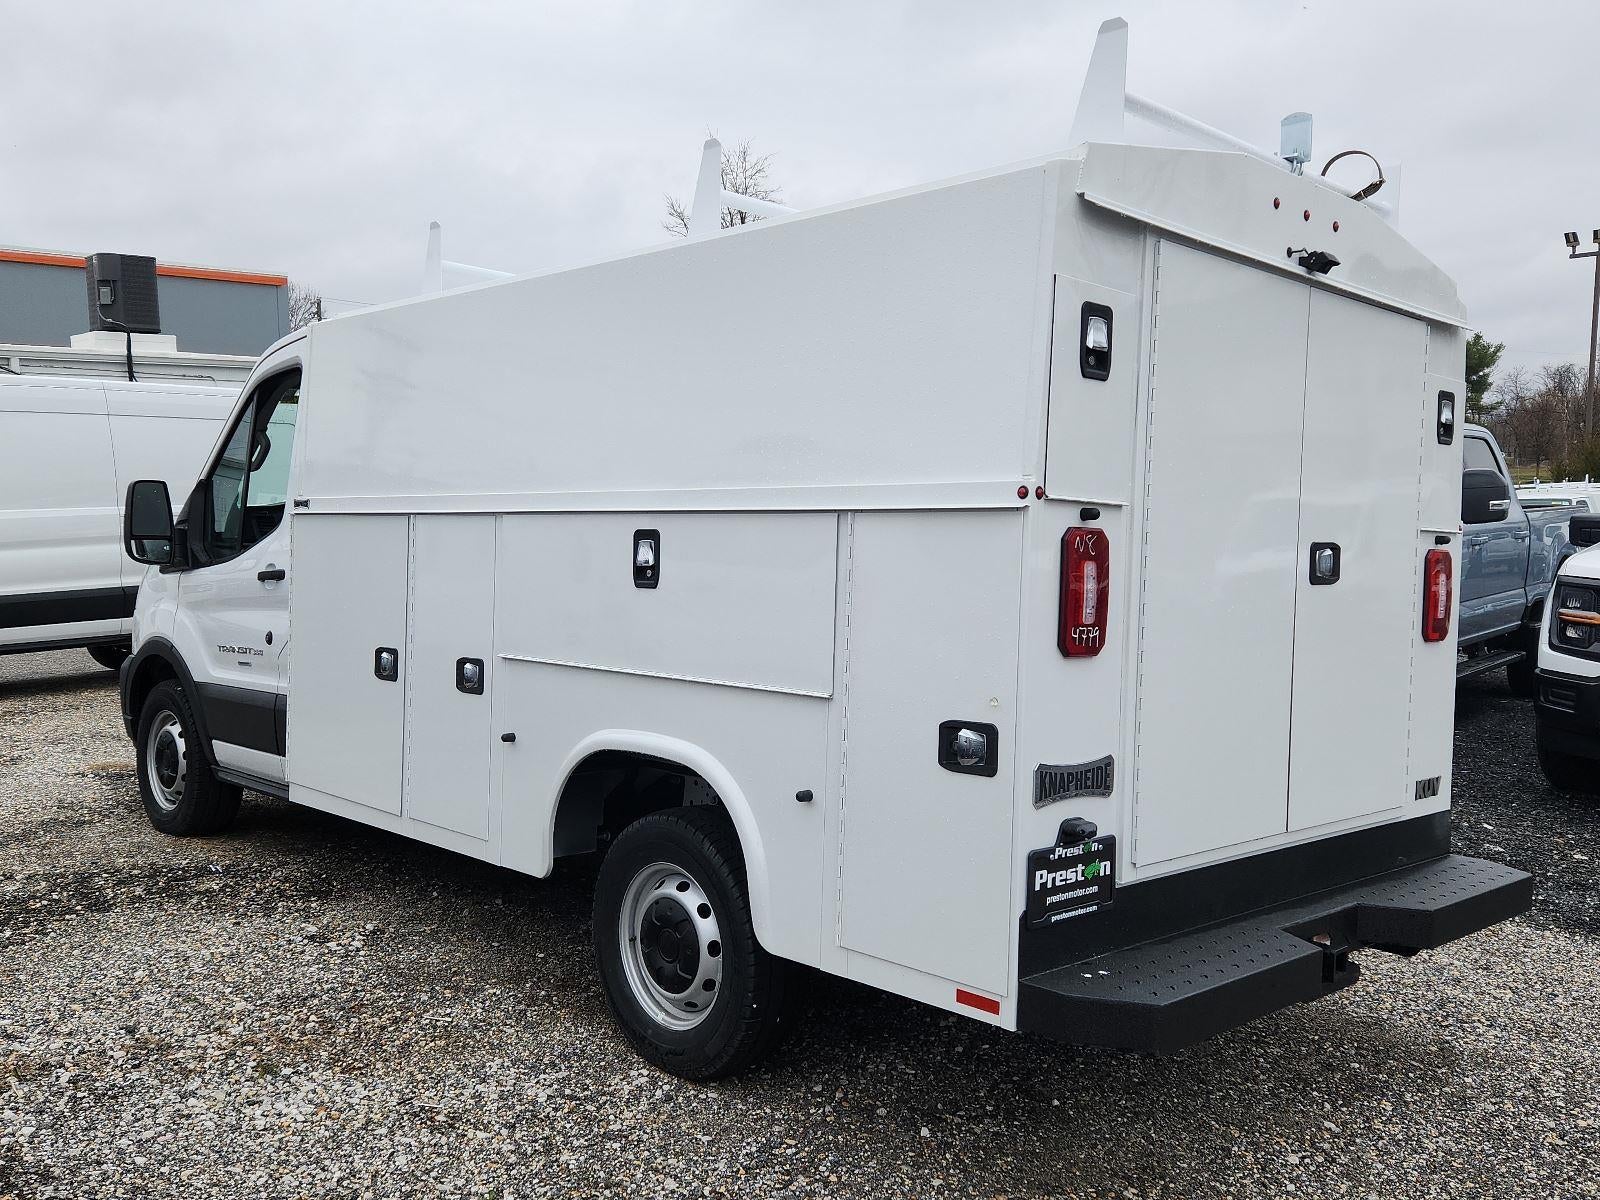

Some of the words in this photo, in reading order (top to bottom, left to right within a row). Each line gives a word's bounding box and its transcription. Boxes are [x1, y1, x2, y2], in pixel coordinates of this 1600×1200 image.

[1071, 626, 1100, 648] 4779
[1039, 761, 1112, 801] KNAPHEIDE
[1034, 859, 1111, 891] Preston
[1046, 885, 1099, 906] prestonmotor.com
[1051, 904, 1098, 923] prestonmotor.com
